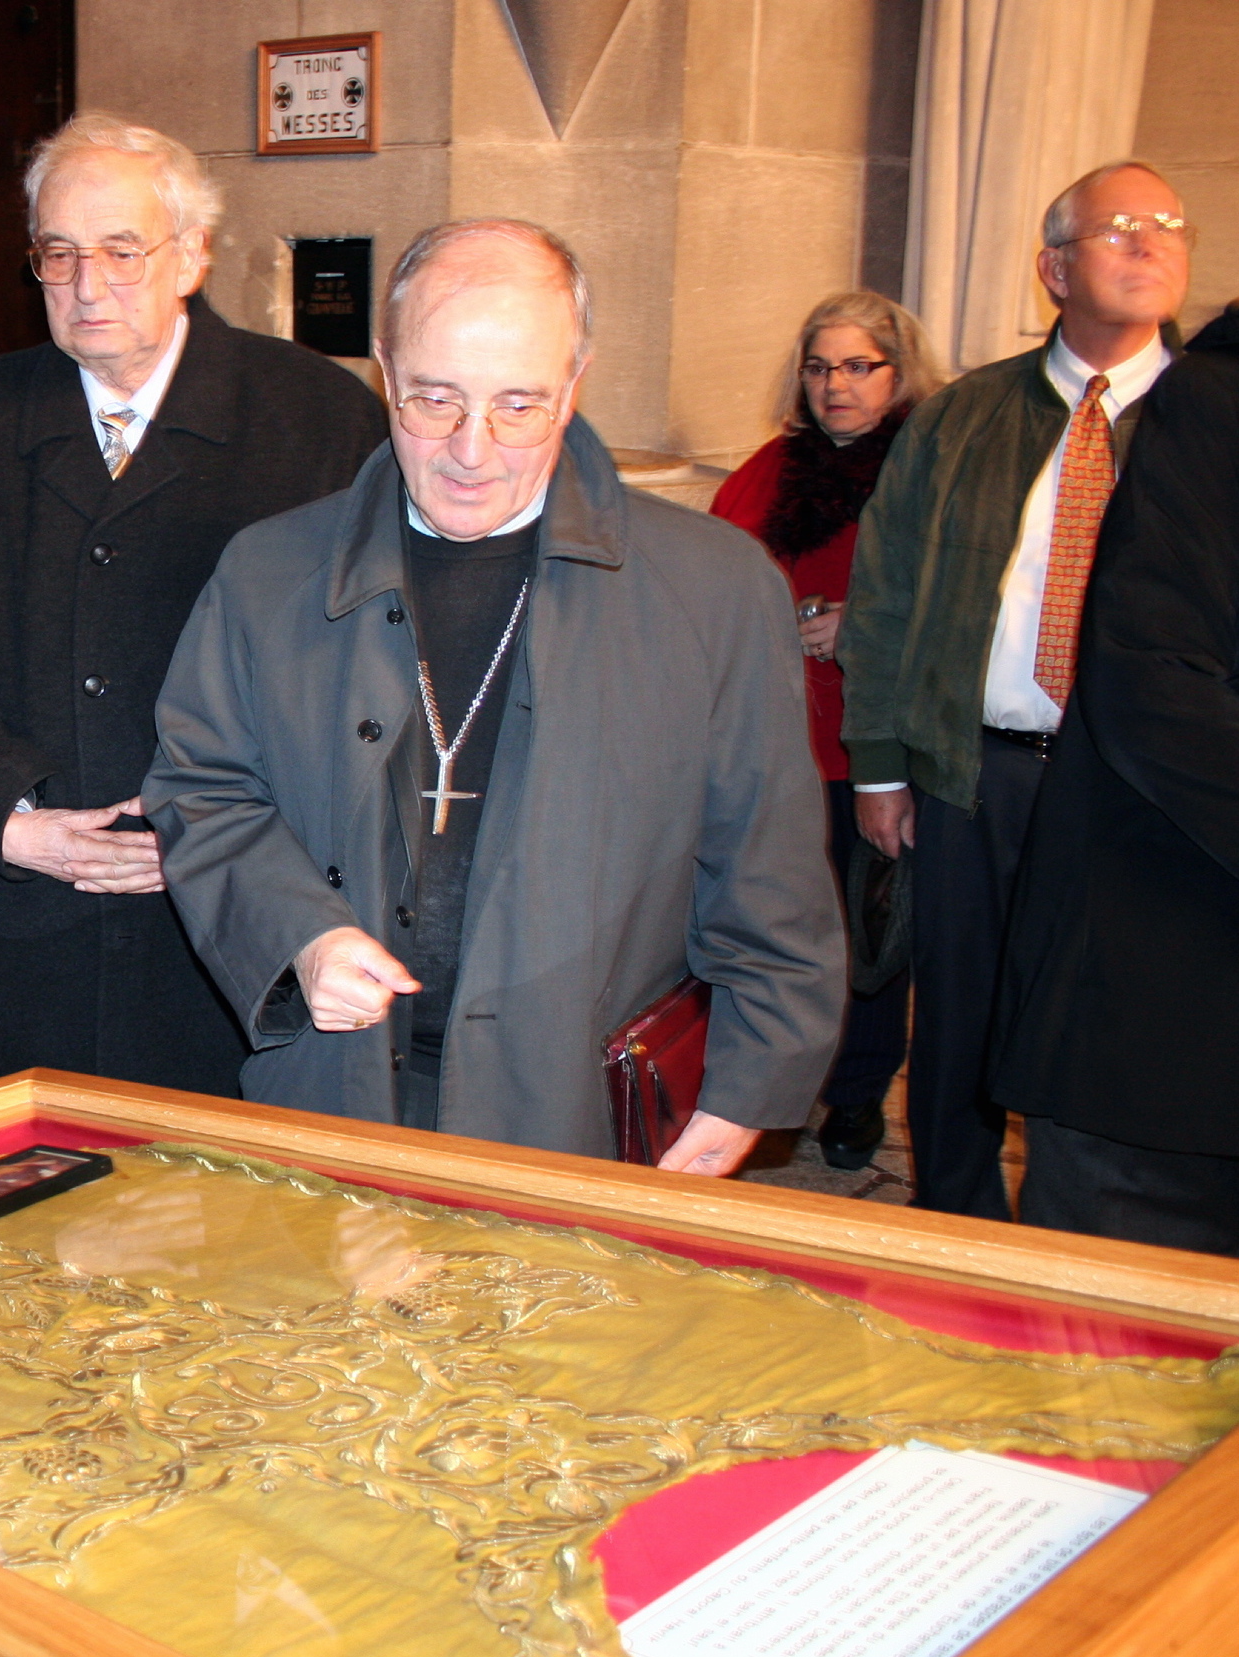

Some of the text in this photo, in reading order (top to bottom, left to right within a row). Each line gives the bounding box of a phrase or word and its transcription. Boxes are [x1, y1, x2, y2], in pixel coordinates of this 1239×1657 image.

[293, 57, 343, 75] TRONC
[306, 89, 329, 101] DES
[281, 112, 356, 136] MESSES
